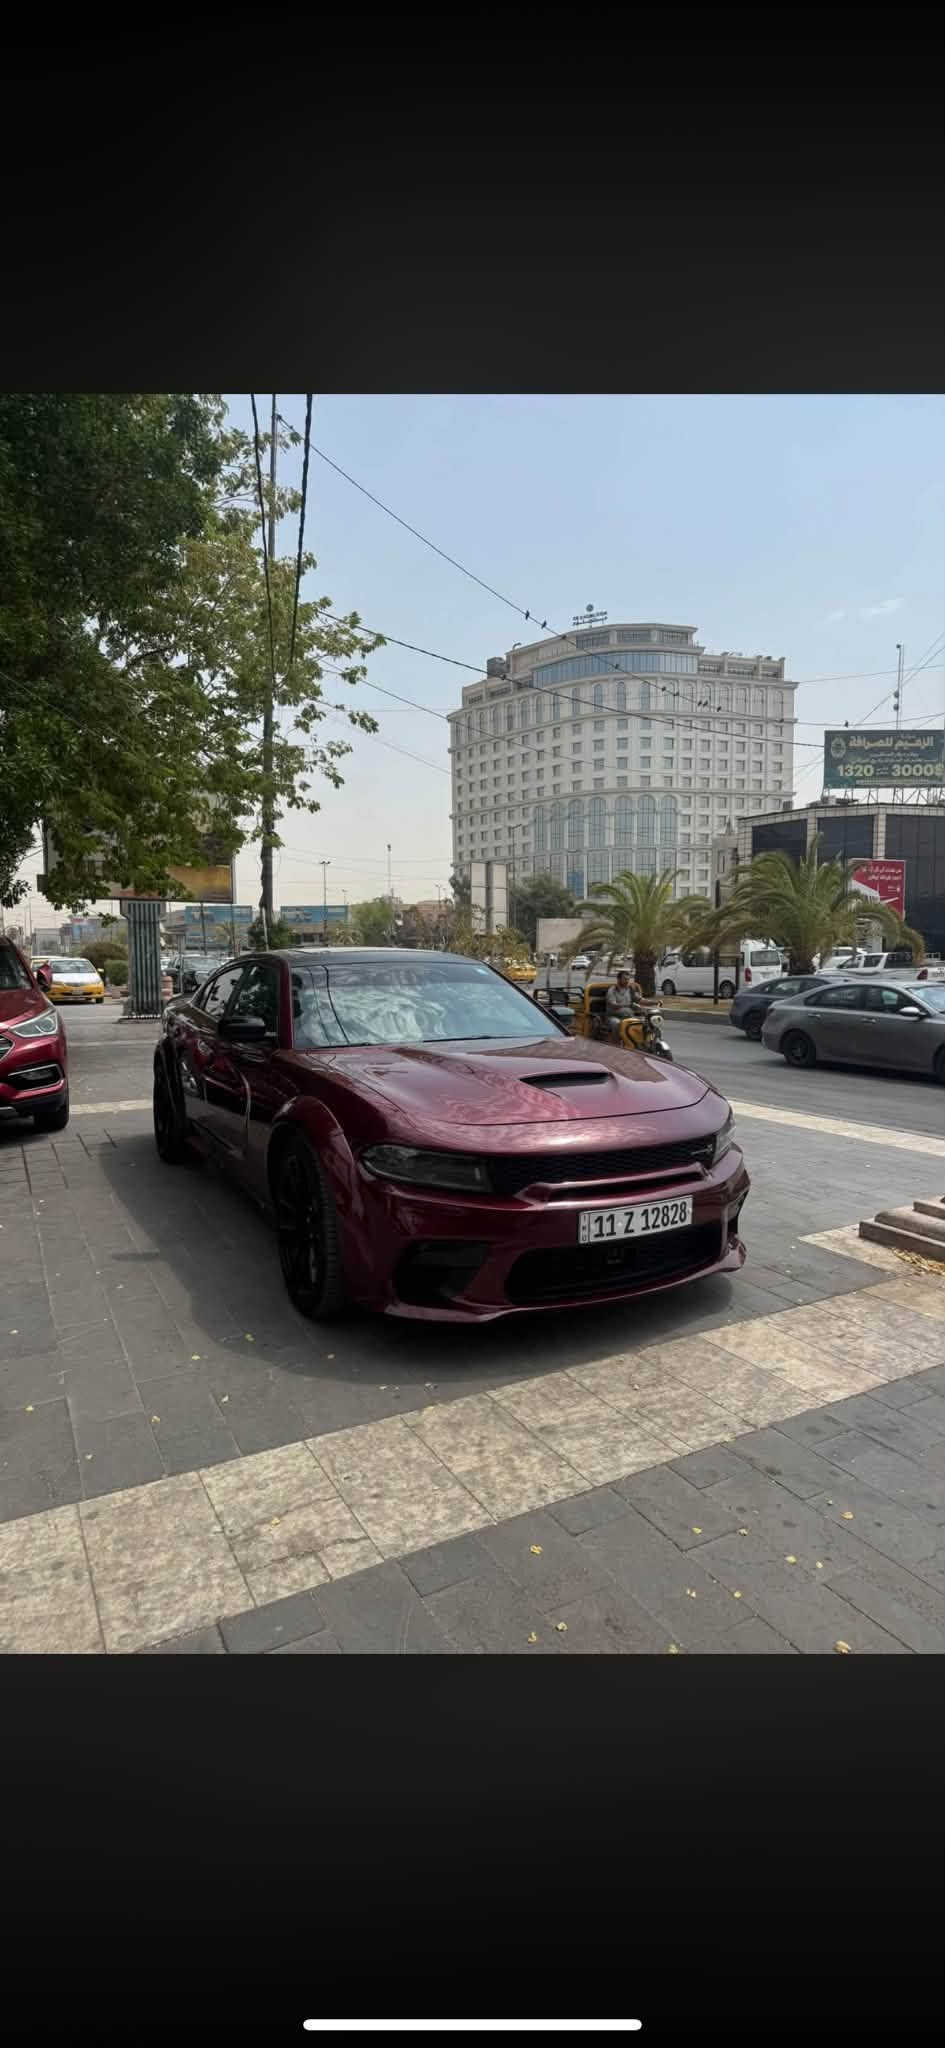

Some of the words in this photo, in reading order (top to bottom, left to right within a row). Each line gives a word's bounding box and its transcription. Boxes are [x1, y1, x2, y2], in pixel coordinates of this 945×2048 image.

[838, 764, 874, 777] 1320
[594, 1215, 616, 1238] 11
[623, 1211, 635, 1234] Z
[641, 1201, 687, 1231] 12828
